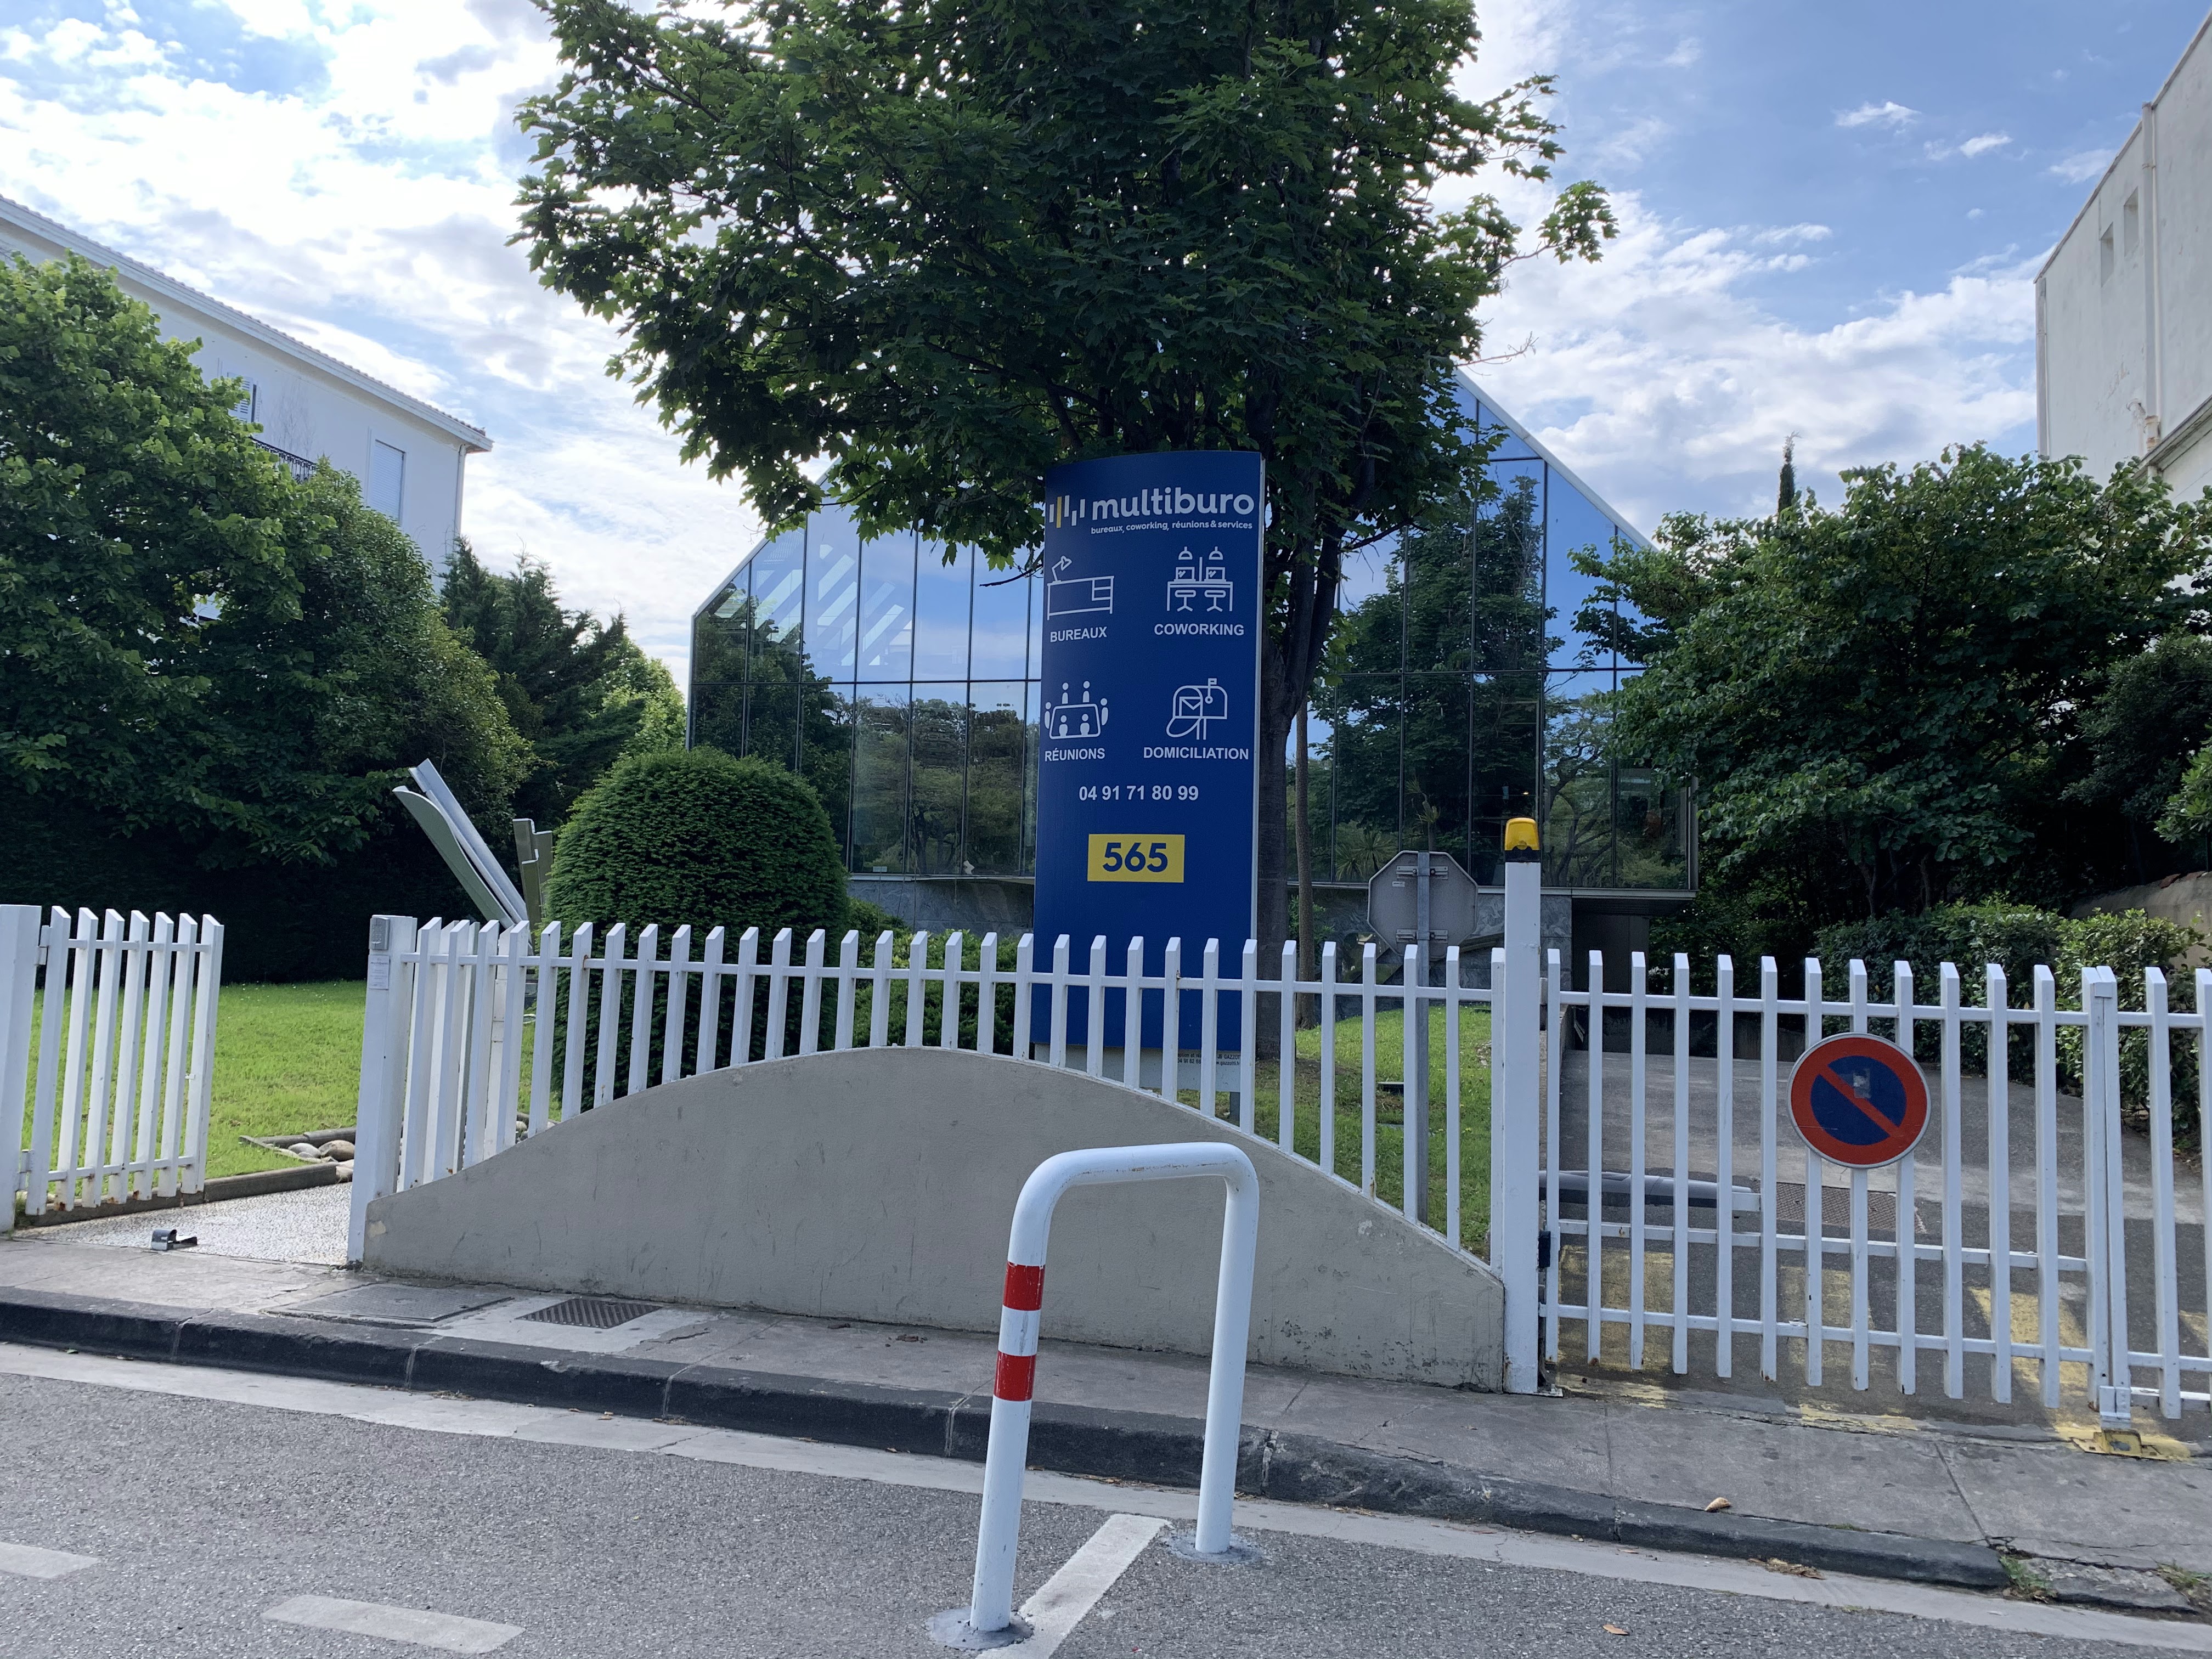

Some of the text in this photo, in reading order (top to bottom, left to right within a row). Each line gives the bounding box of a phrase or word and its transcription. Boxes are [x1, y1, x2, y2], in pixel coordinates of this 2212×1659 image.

[1092, 487, 1255, 521] multiburo
[1091, 524, 1125, 534] bureaux,
[1126, 522, 1170, 531] coworking,
[1172, 520, 1209, 528] réunions
[1217, 521, 1252, 529] services
[1050, 627, 1107, 642] BUREAUX
[1154, 624, 1244, 636] COWORKING
[1045, 747, 1105, 762] RÉUNIONS
[1143, 747, 1249, 760] DOMICILIATION
[1079, 785, 1199, 801] 04 91 71 80 99
[1102, 842, 1168, 872] 565
